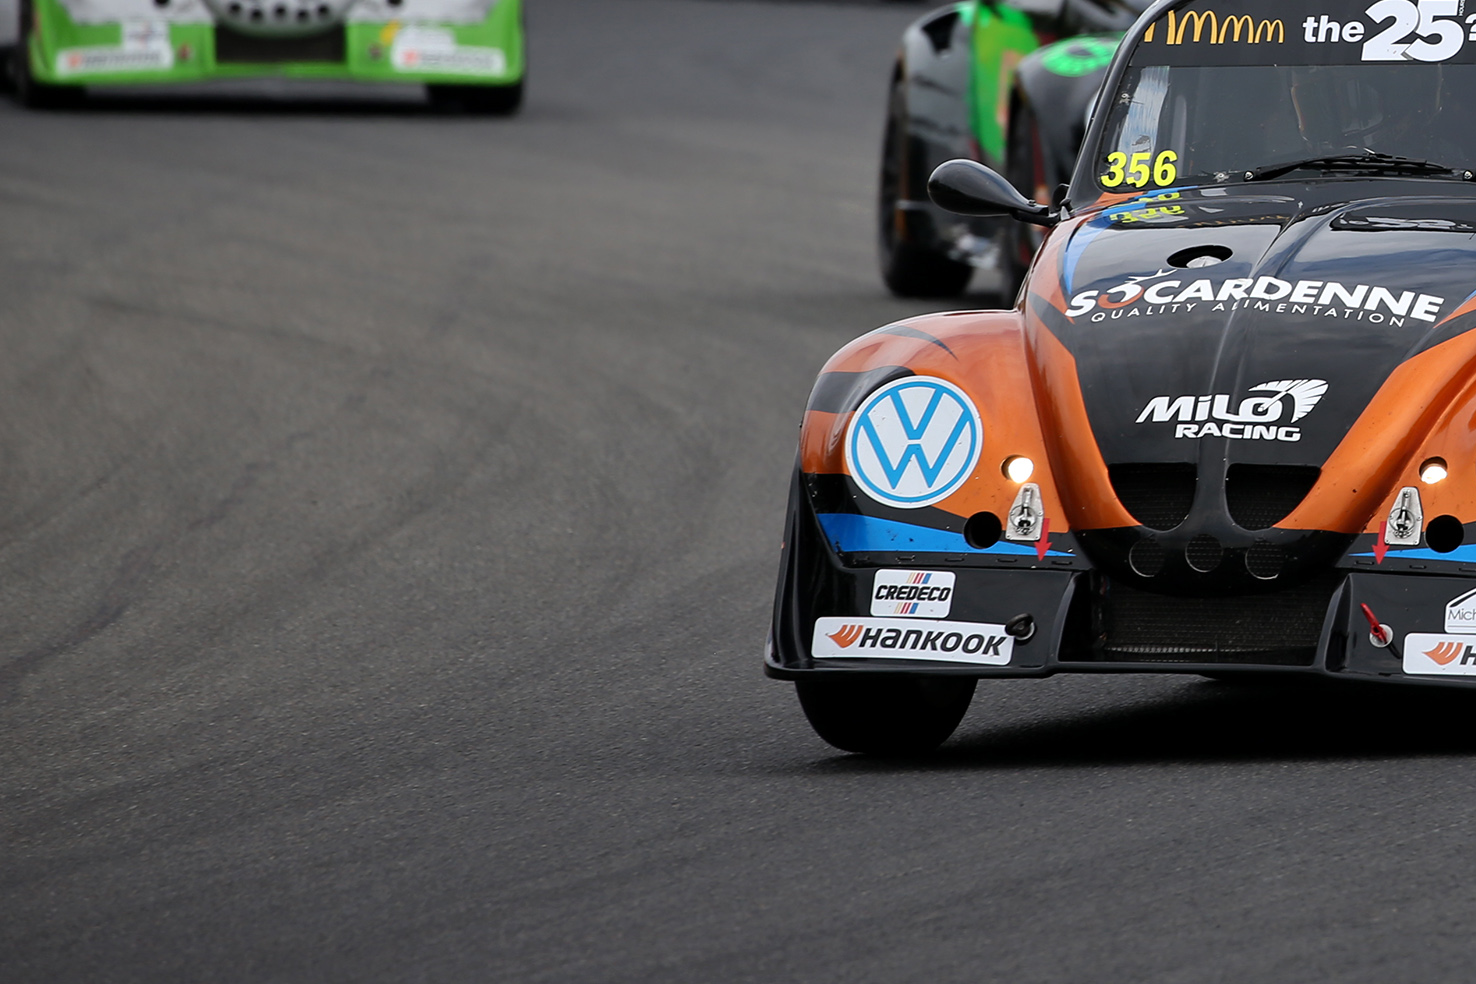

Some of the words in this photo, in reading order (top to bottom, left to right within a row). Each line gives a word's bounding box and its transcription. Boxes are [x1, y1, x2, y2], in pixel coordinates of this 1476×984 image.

[1302, 14, 1365, 43] the
[1101, 150, 1178, 188] 356
[1066, 272, 1445, 324] SOCARDENNE
[1091, 302, 1196, 323] QUALITY
[1212, 298, 1405, 328] ALIMENTATION
[1174, 422, 1302, 443] RACING
[874, 584, 952, 602] CREDECO
